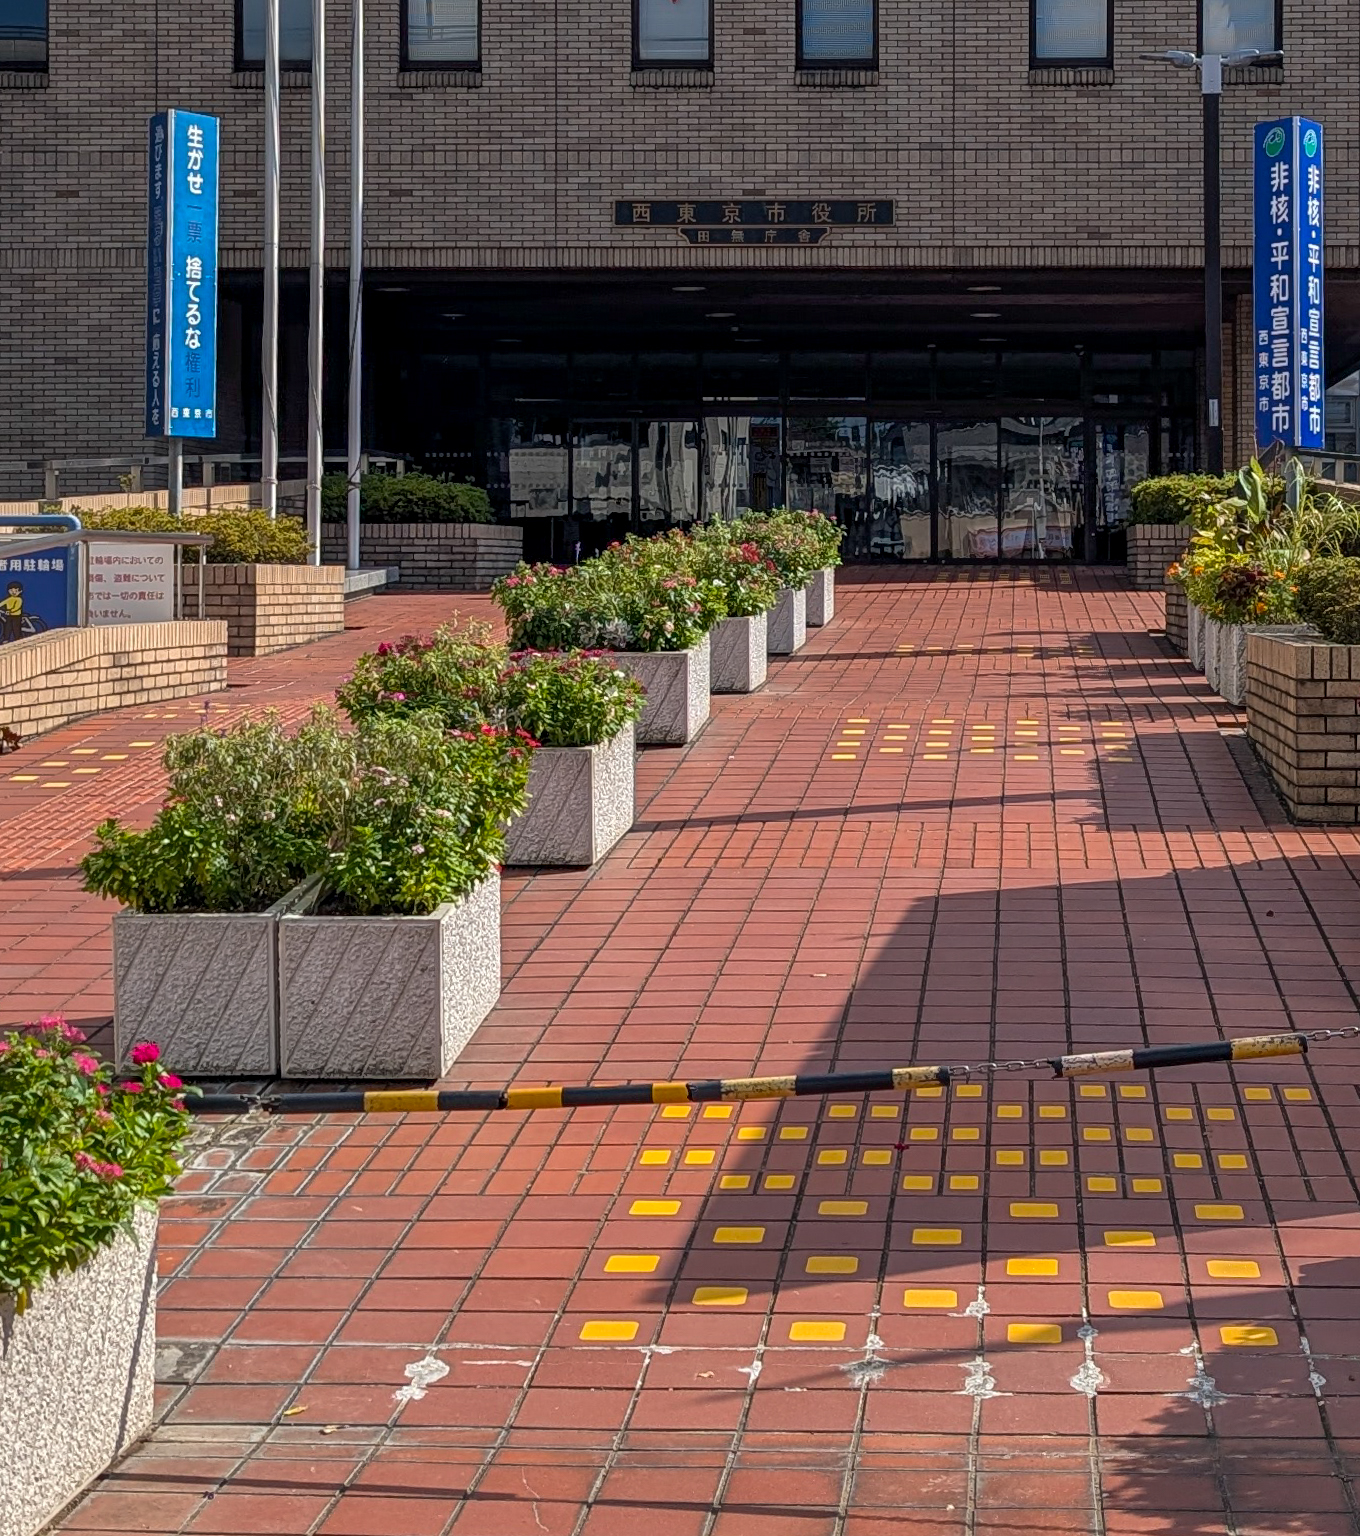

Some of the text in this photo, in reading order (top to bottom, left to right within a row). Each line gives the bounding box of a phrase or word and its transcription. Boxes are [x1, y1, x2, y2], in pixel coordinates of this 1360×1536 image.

[632, 202, 877, 224] 西東京市役所
[1269, 161, 1291, 434] 非核・平和宣言都市
[1307, 164, 1321, 435] 非核・平和宣言都市
[1259, 331, 1269, 412] 西東京市
